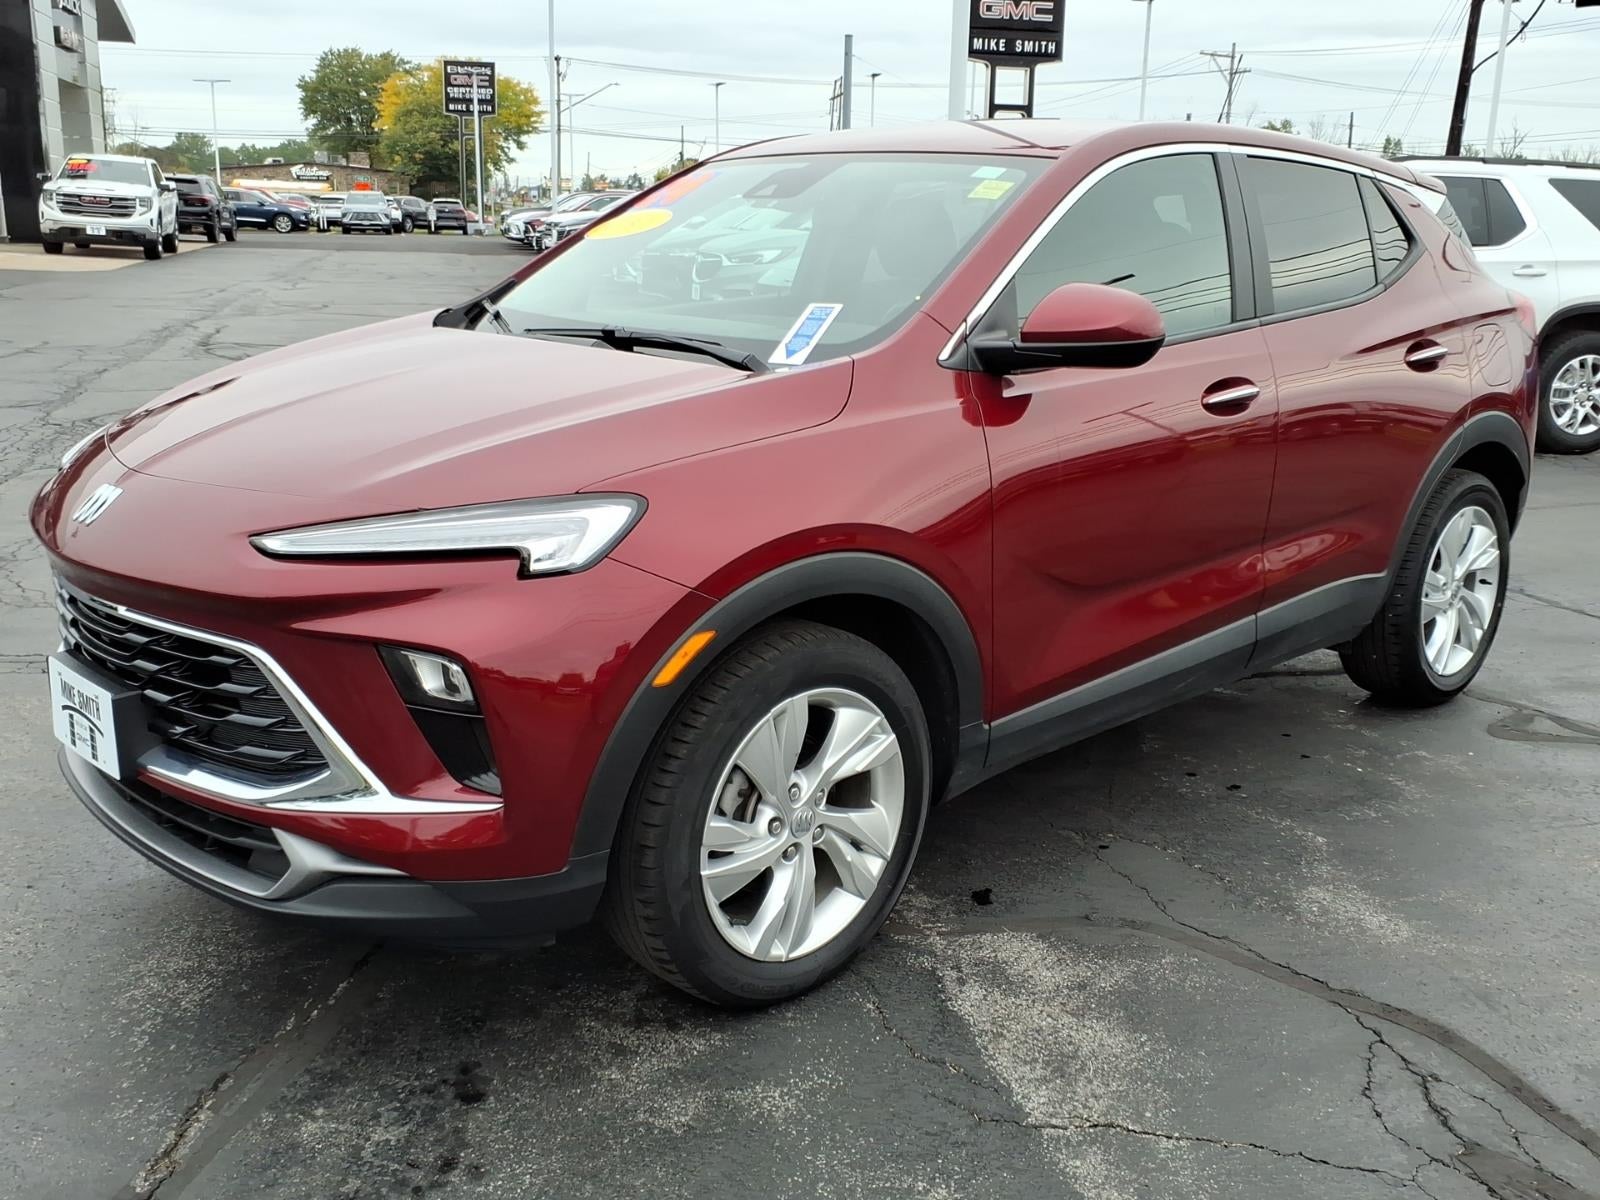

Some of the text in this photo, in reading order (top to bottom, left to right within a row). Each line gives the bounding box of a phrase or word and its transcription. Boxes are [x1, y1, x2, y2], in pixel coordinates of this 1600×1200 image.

[980, 0, 1055, 22] GMC
[973, 37, 1057, 54] MIKE SMITH
[446, 86, 494, 95] CERTIIED
[448, 103, 467, 111] MIKE
[60, 677, 102, 722] MIKE SMITH
